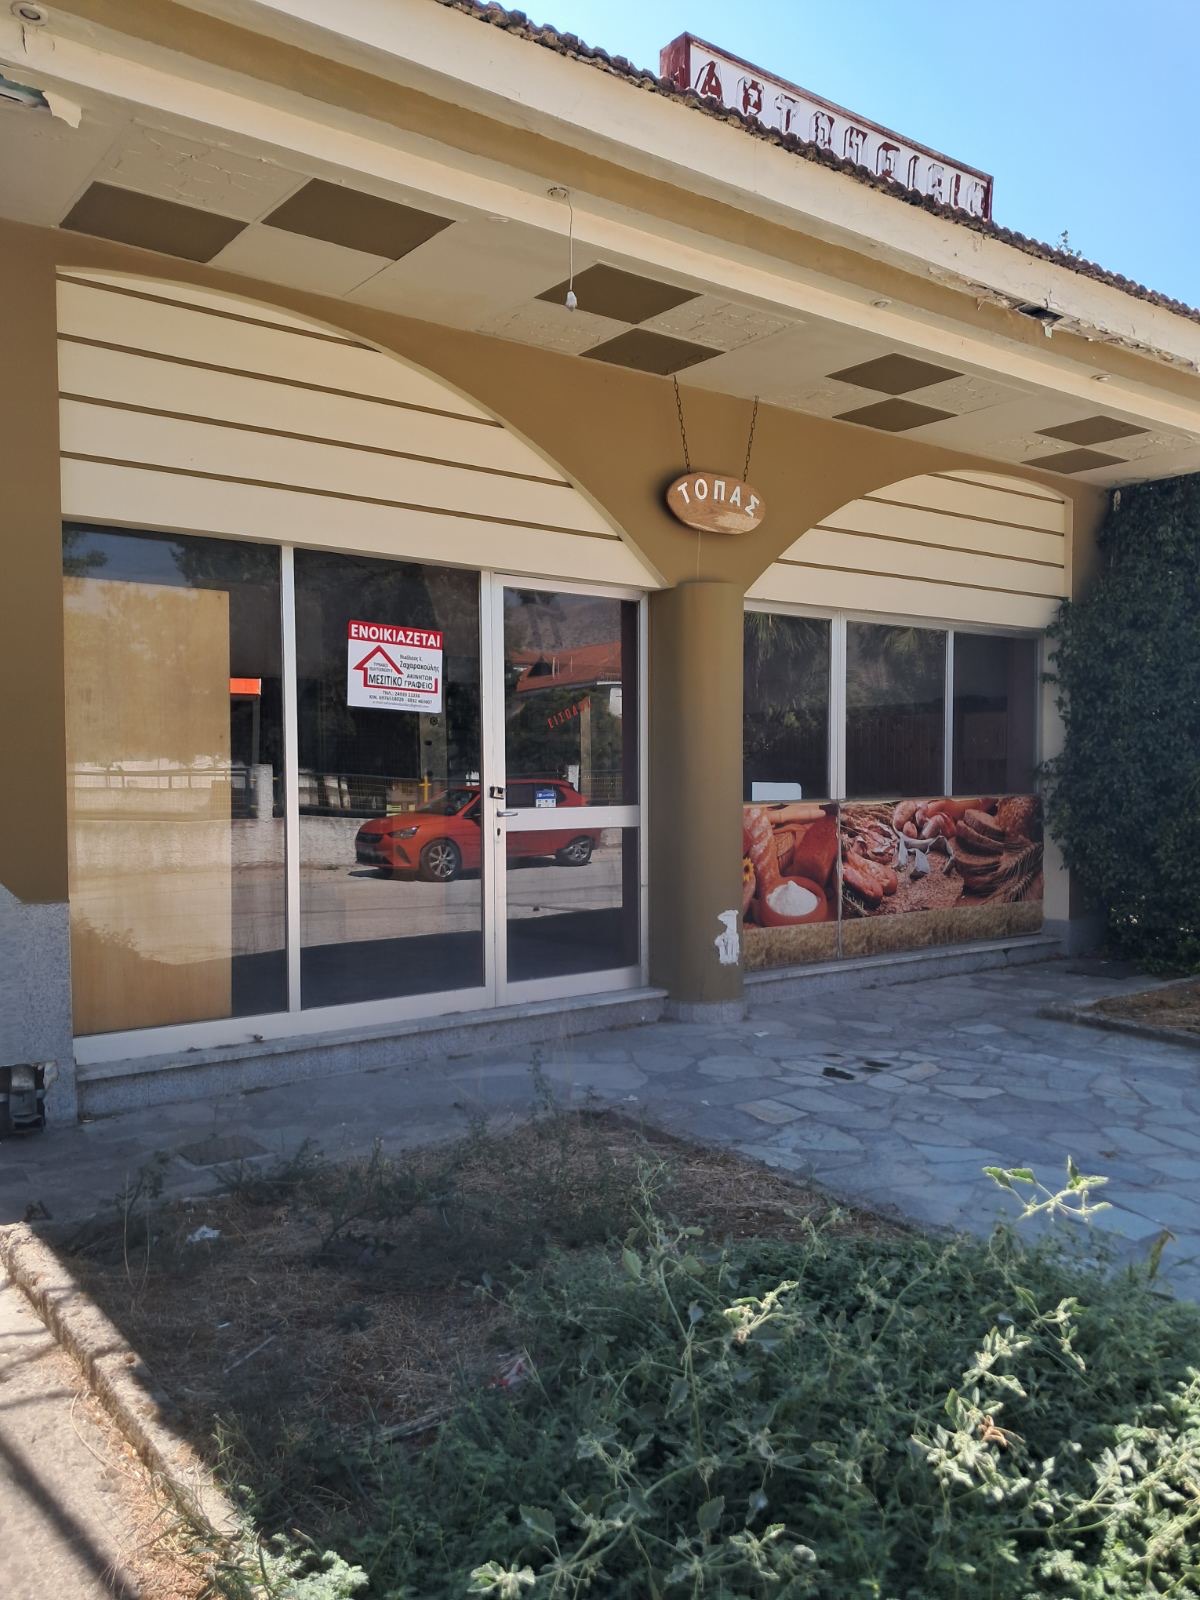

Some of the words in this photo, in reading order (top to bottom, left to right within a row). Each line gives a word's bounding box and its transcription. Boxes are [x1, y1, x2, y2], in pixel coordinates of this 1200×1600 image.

[677, 478, 760, 518] ΤΟΠΑΣ
[351, 623, 441, 648] ΕΝΟΙΚΙΑΖΕΤΑΙ
[368, 673, 403, 687] ΜΕΣΙΤΙΚΟ
